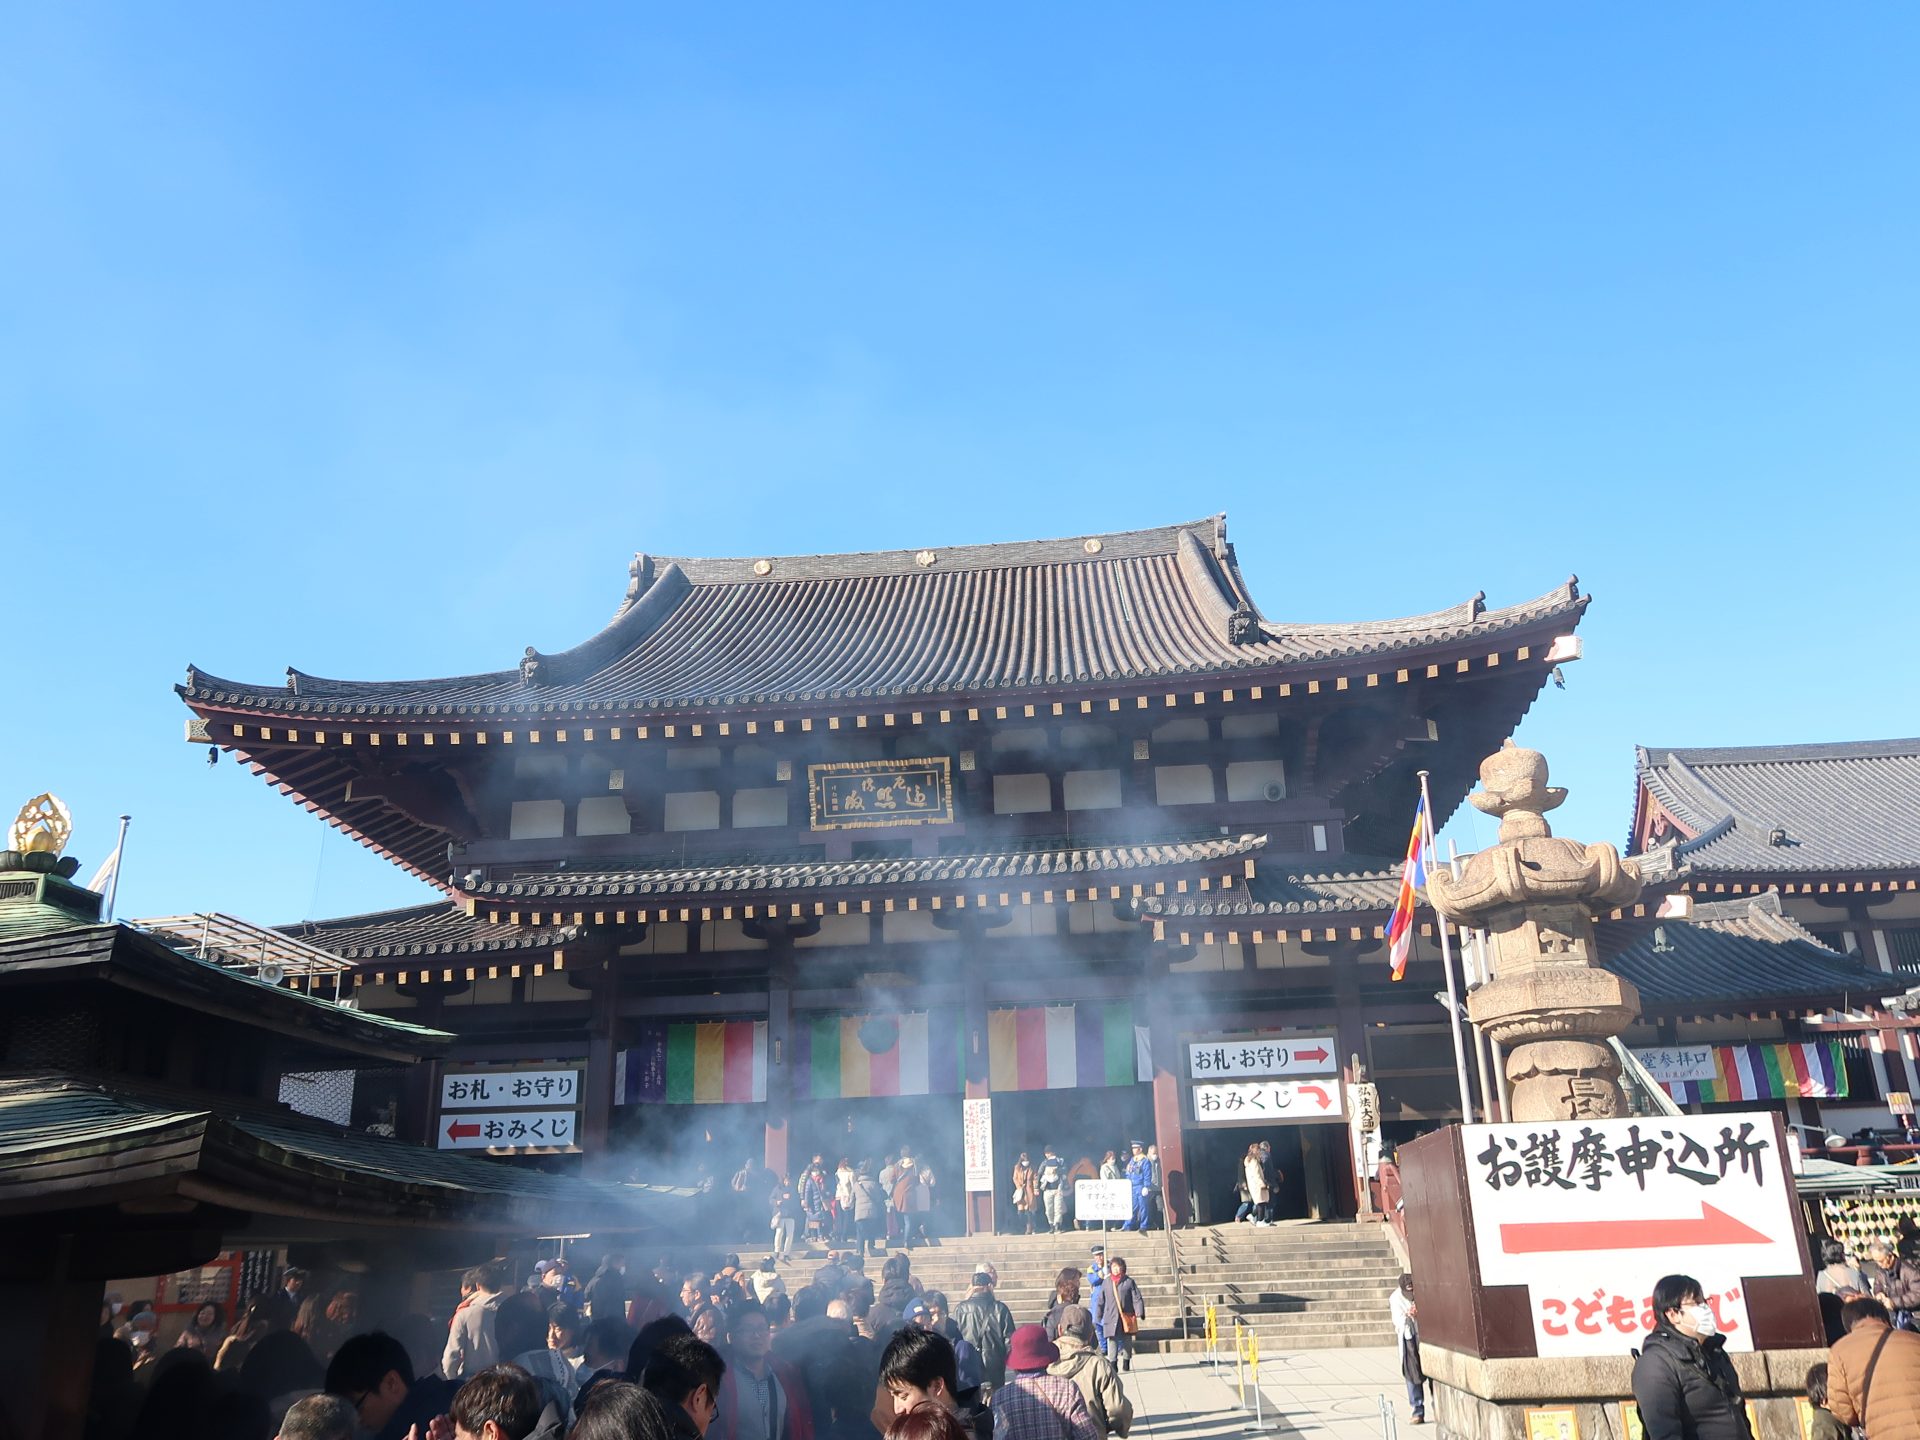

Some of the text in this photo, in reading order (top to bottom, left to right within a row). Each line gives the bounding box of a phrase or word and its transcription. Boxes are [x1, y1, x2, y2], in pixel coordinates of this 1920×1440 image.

[1195, 1047, 1289, 1070] お札・お守り
[448, 1077, 573, 1100] お札・お守り
[1201, 1090, 1292, 1112] おみくじ
[1358, 1086, 1374, 1128] 弘法大師
[484, 1118, 568, 1140] おみくじ
[1477, 1122, 1770, 1192] お護摩申込所
[1079, 1183, 1108, 1191] ゆっくり
[1542, 1287, 1742, 1337] こどもじ
